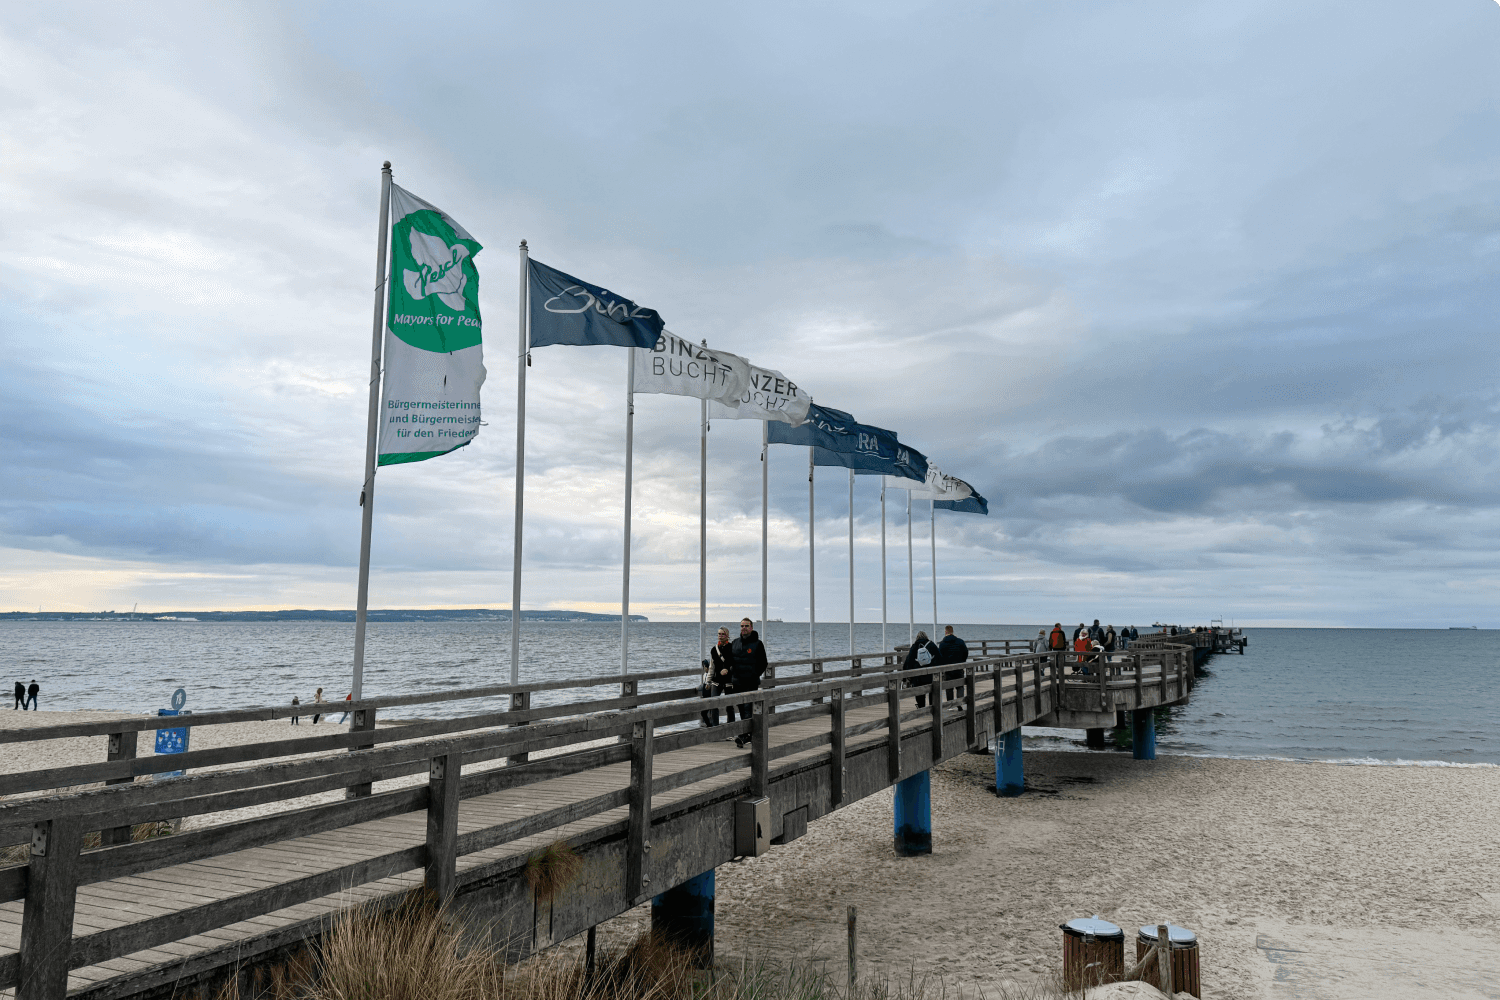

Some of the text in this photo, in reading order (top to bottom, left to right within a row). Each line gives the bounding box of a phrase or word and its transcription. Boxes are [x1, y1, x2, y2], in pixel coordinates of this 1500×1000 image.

[544, 285, 652, 320] Binz
[393, 313, 482, 329] Mayors for Pea
[652, 356, 733, 387] BUCHT
[749, 373, 798, 398] NZER
[389, 413, 409, 423] und
[397, 428, 476, 438] für den Frieden
